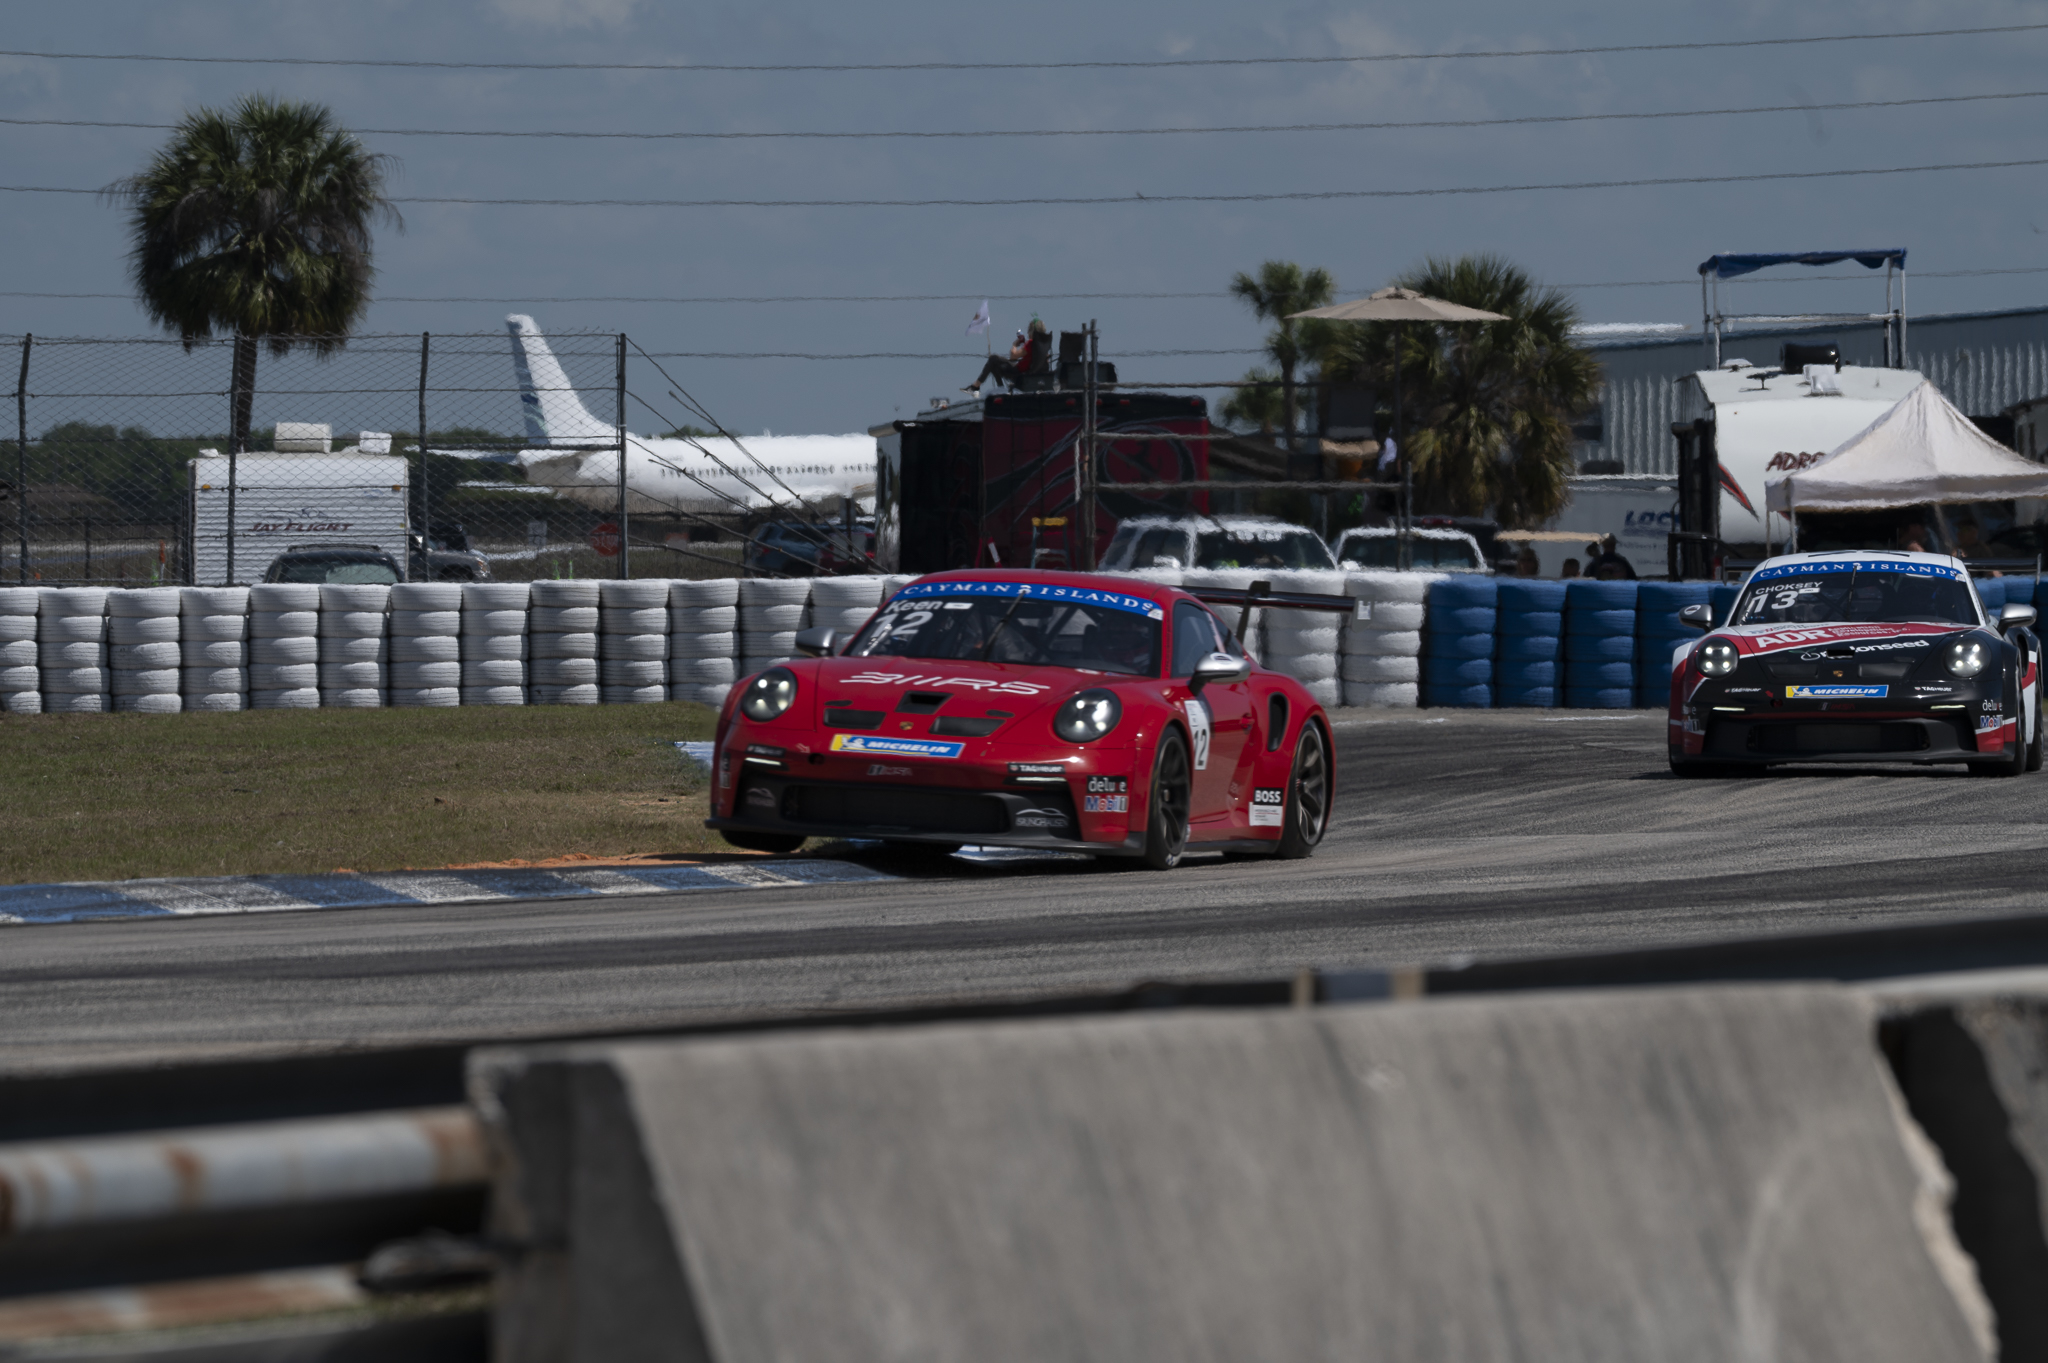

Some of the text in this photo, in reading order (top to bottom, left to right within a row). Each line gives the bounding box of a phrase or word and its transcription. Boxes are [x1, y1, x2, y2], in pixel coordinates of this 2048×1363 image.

[248, 520, 354, 532] JAY FLIGHT
[1759, 563, 1957, 578] CAYMAN ISLANDS
[1755, 581, 1824, 595] CHOKSEY
[903, 583, 1154, 612] CAYMAN ISLANDS
[1753, 591, 1799, 613] 13
[883, 599, 944, 614] Keen
[870, 611, 934, 639] 12
[1755, 629, 1835, 649] ADR
[1813, 687, 1880, 696] MICHELIN
[867, 740, 952, 754] MICHELIN
[1254, 789, 1282, 803] BOSS
